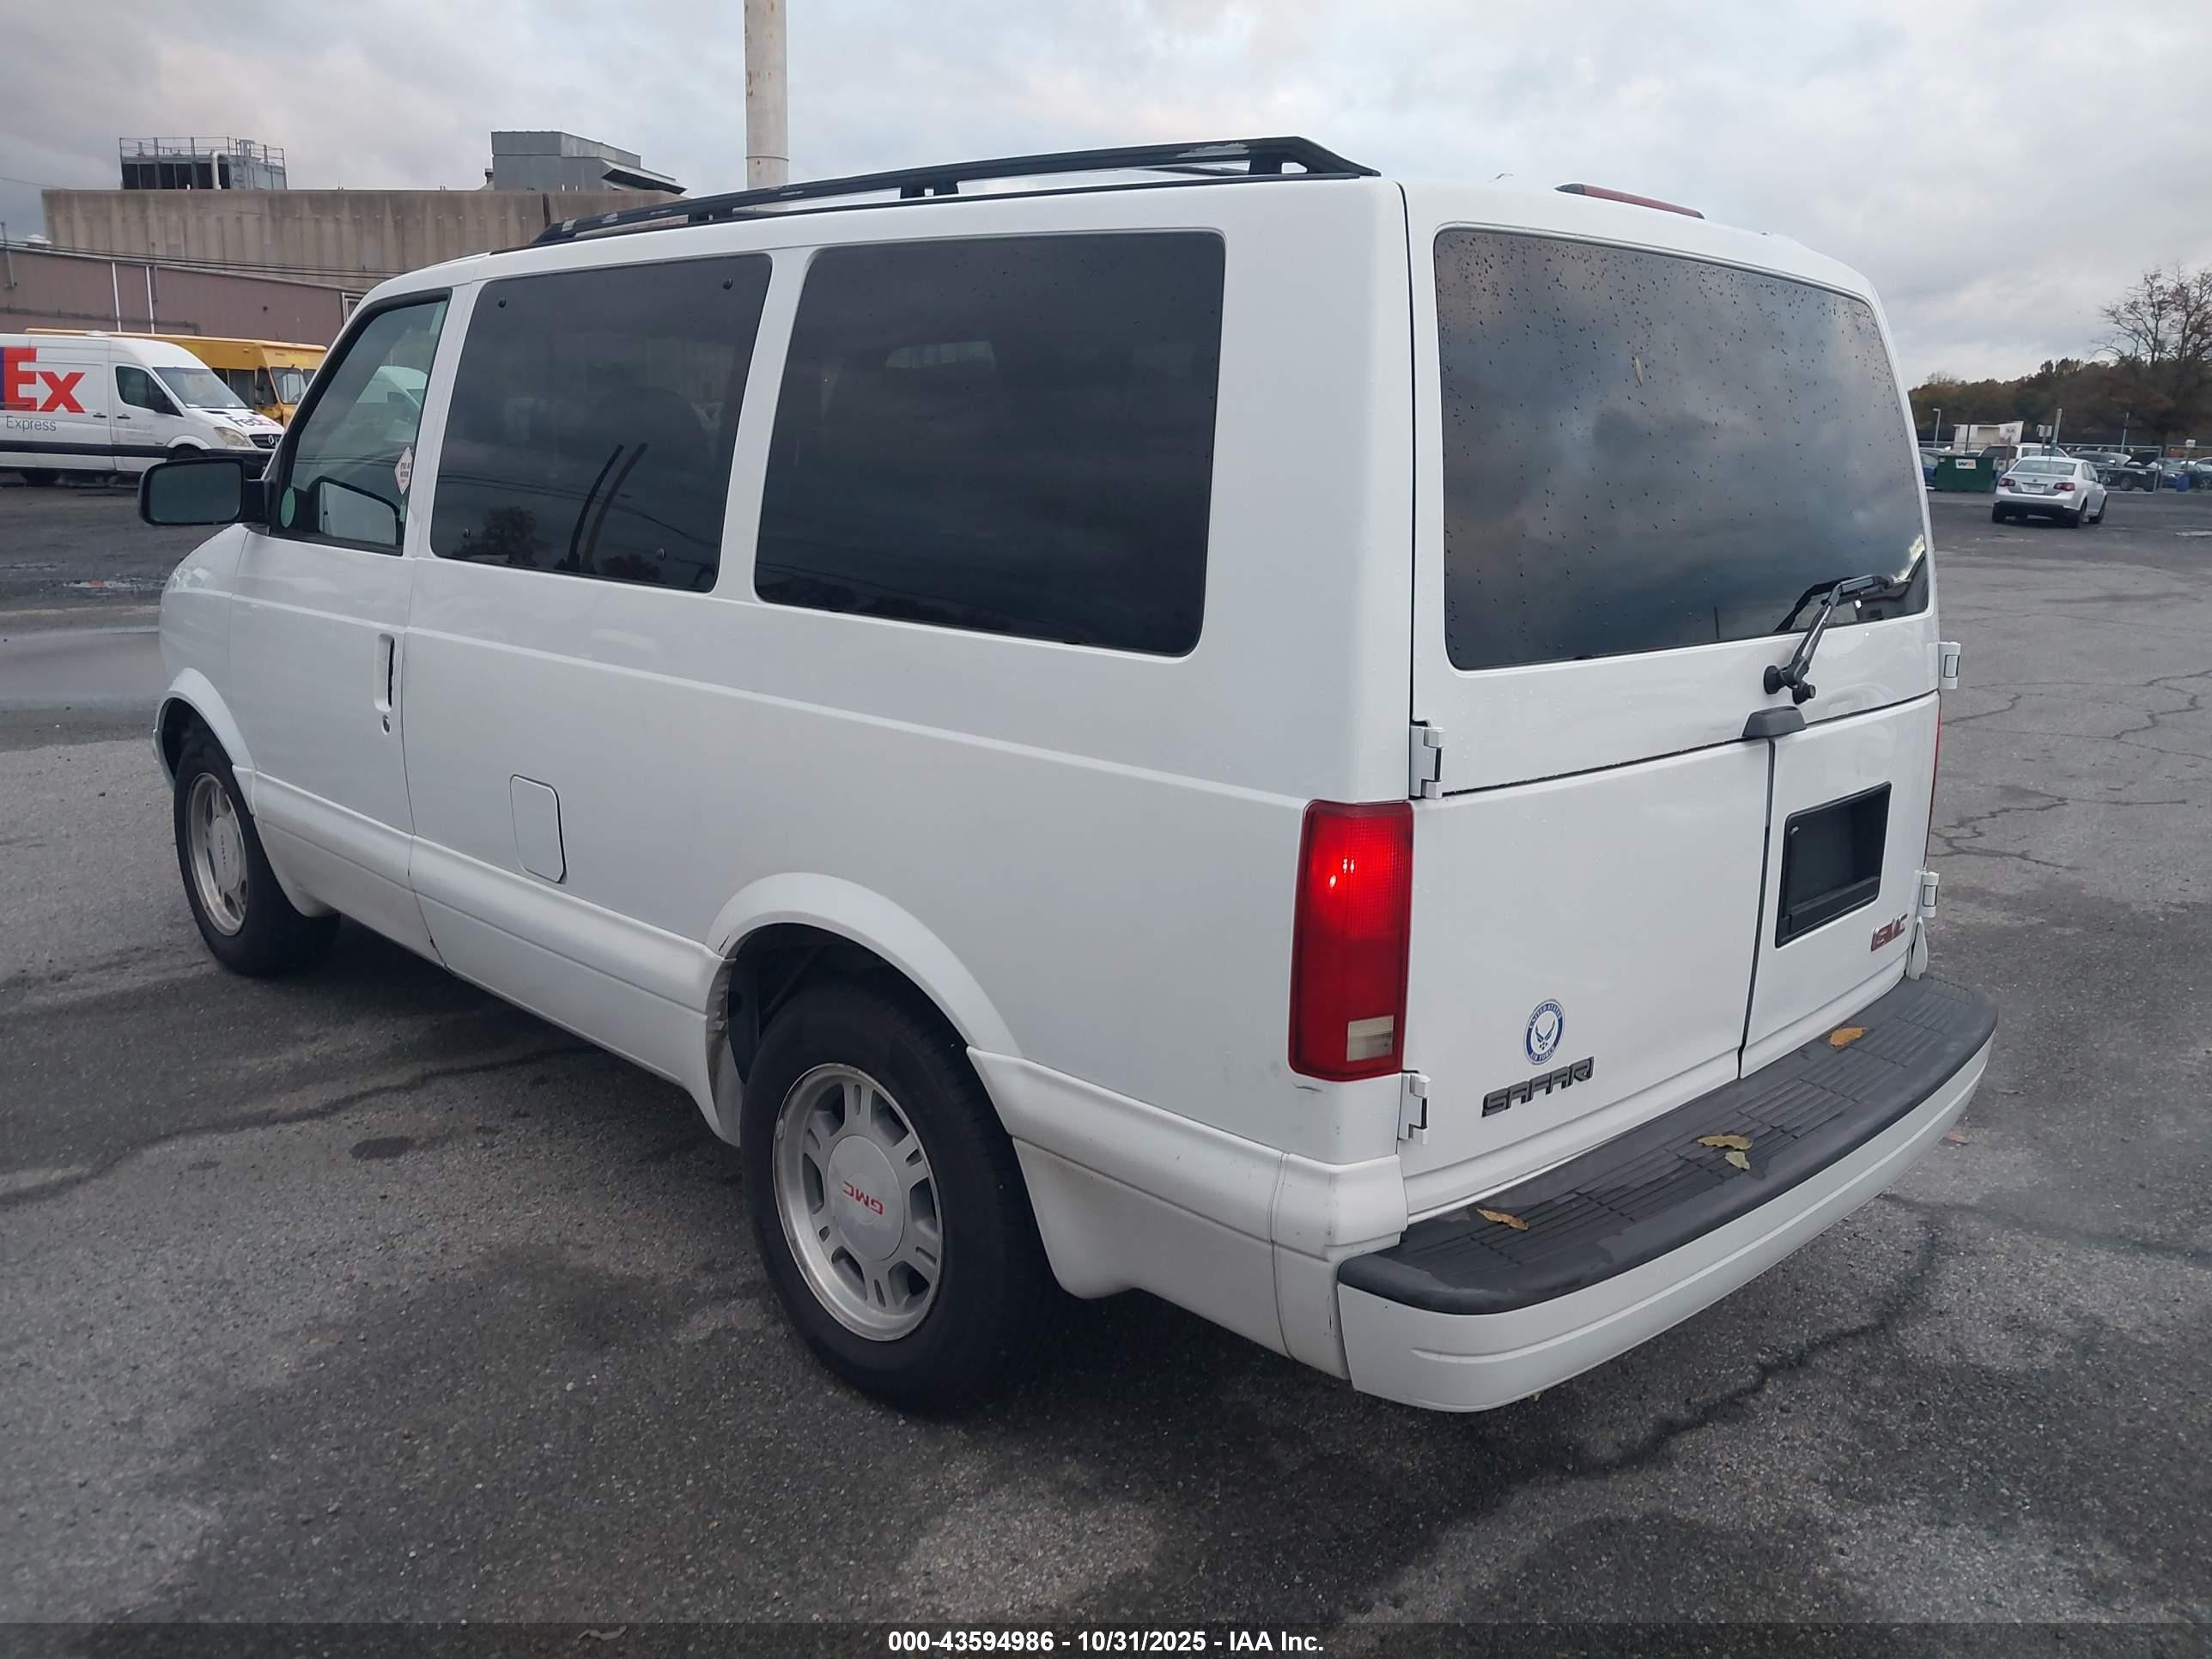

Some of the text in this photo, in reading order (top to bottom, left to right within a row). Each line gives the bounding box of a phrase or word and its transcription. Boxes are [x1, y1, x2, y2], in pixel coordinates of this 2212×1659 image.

[0, 346, 86, 413] Ex
[6, 415, 57, 433] Express
[1870, 913, 1909, 952] GMC
[1528, 1003, 1562, 1029] UNITED STATES
[1530, 1044, 1556, 1062] AIR FORCE
[1481, 1055, 1595, 1118] SAFARI
[842, 1180, 884, 1215] GMC
